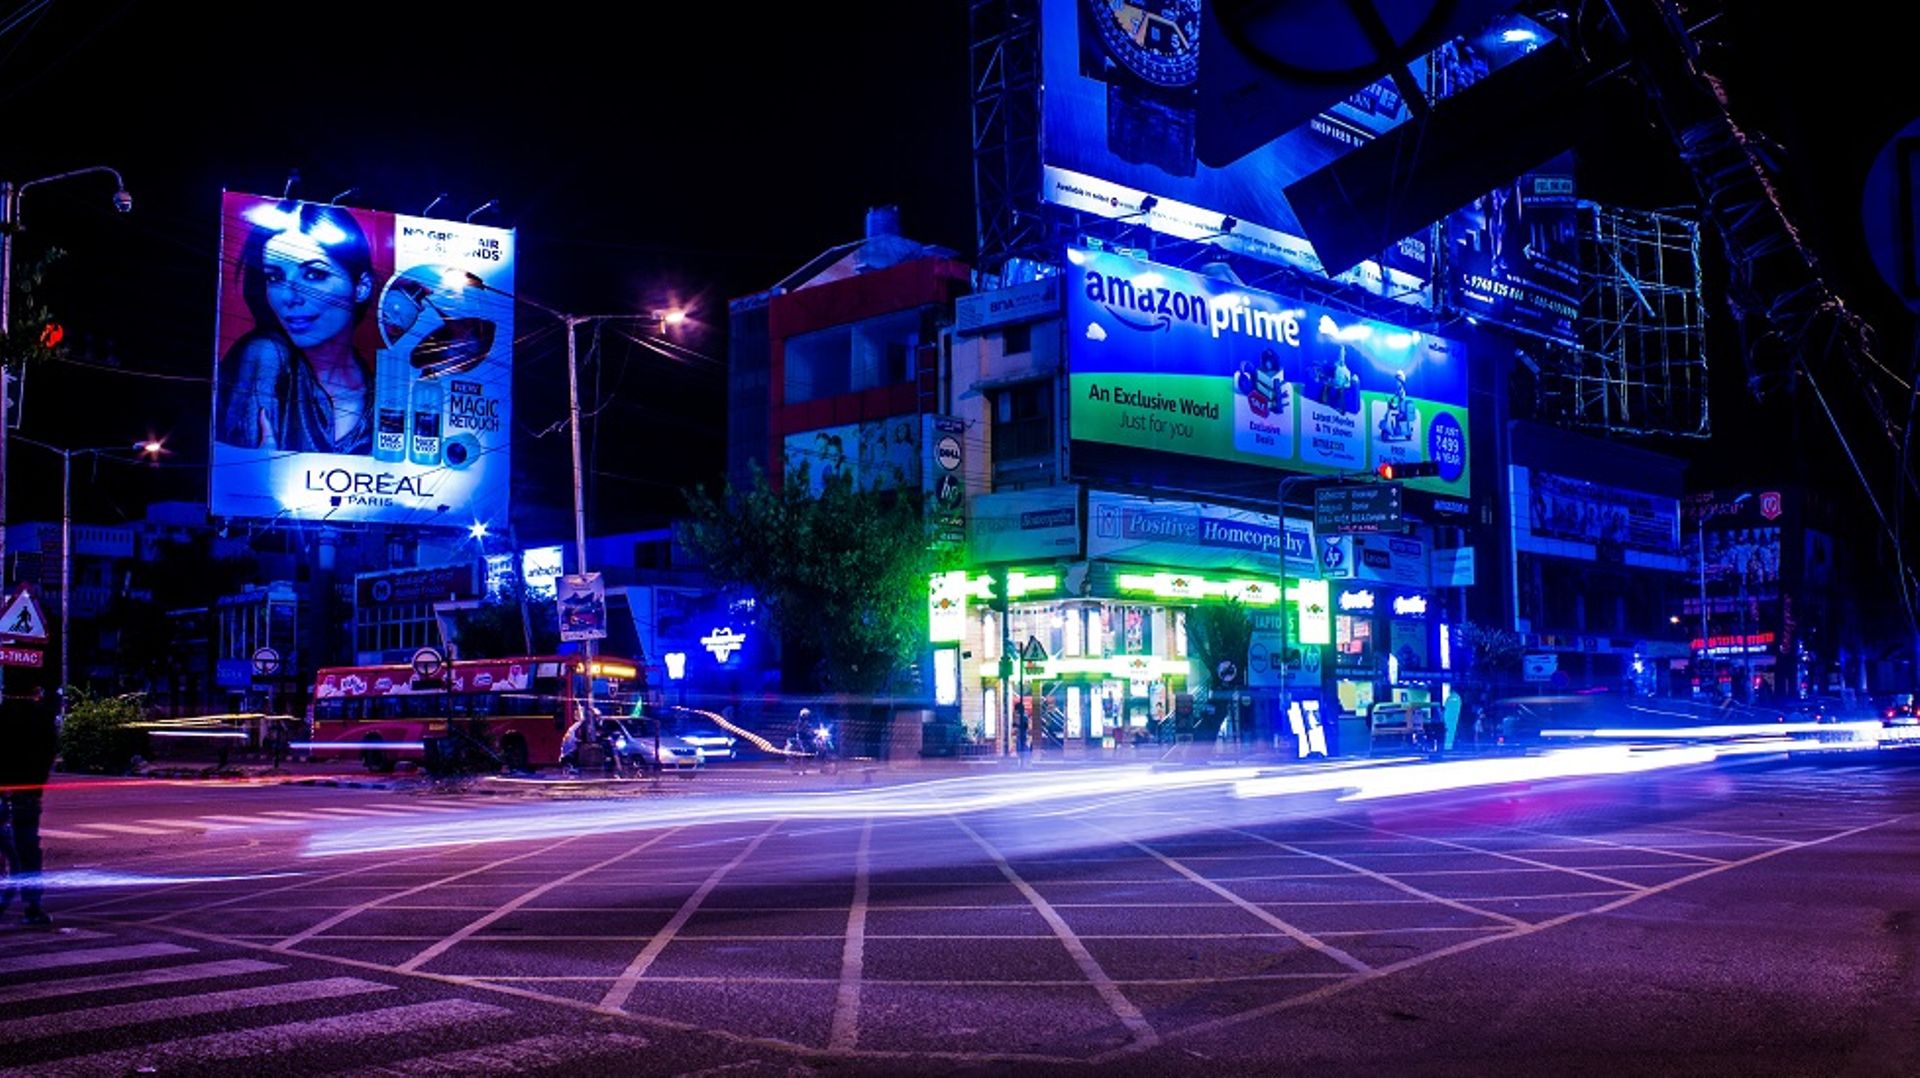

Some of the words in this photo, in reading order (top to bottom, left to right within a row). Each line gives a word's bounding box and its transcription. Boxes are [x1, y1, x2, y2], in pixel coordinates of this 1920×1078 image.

[1171, 33, 1180, 49] 5
[1086, 268, 1208, 325] amazon
[1209, 297, 1300, 347] prime
[451, 395, 499, 419] MAGIC
[1088, 383, 1110, 402] An
[1113, 387, 1178, 412] Exclusive
[1179, 397, 1220, 421] World
[449, 413, 499, 432] RETOUCH
[1119, 411, 1147, 431] Just
[1150, 415, 1167, 434] for
[1168, 422, 1194, 440] you
[1249, 421, 1280, 436] Exclusive
[347, 495, 393, 507] PARIS
[1129, 514, 1198, 537] Positive
[1203, 521, 1306, 556] Homeopahy
[1255, 615, 1295, 633] LAPTOS
